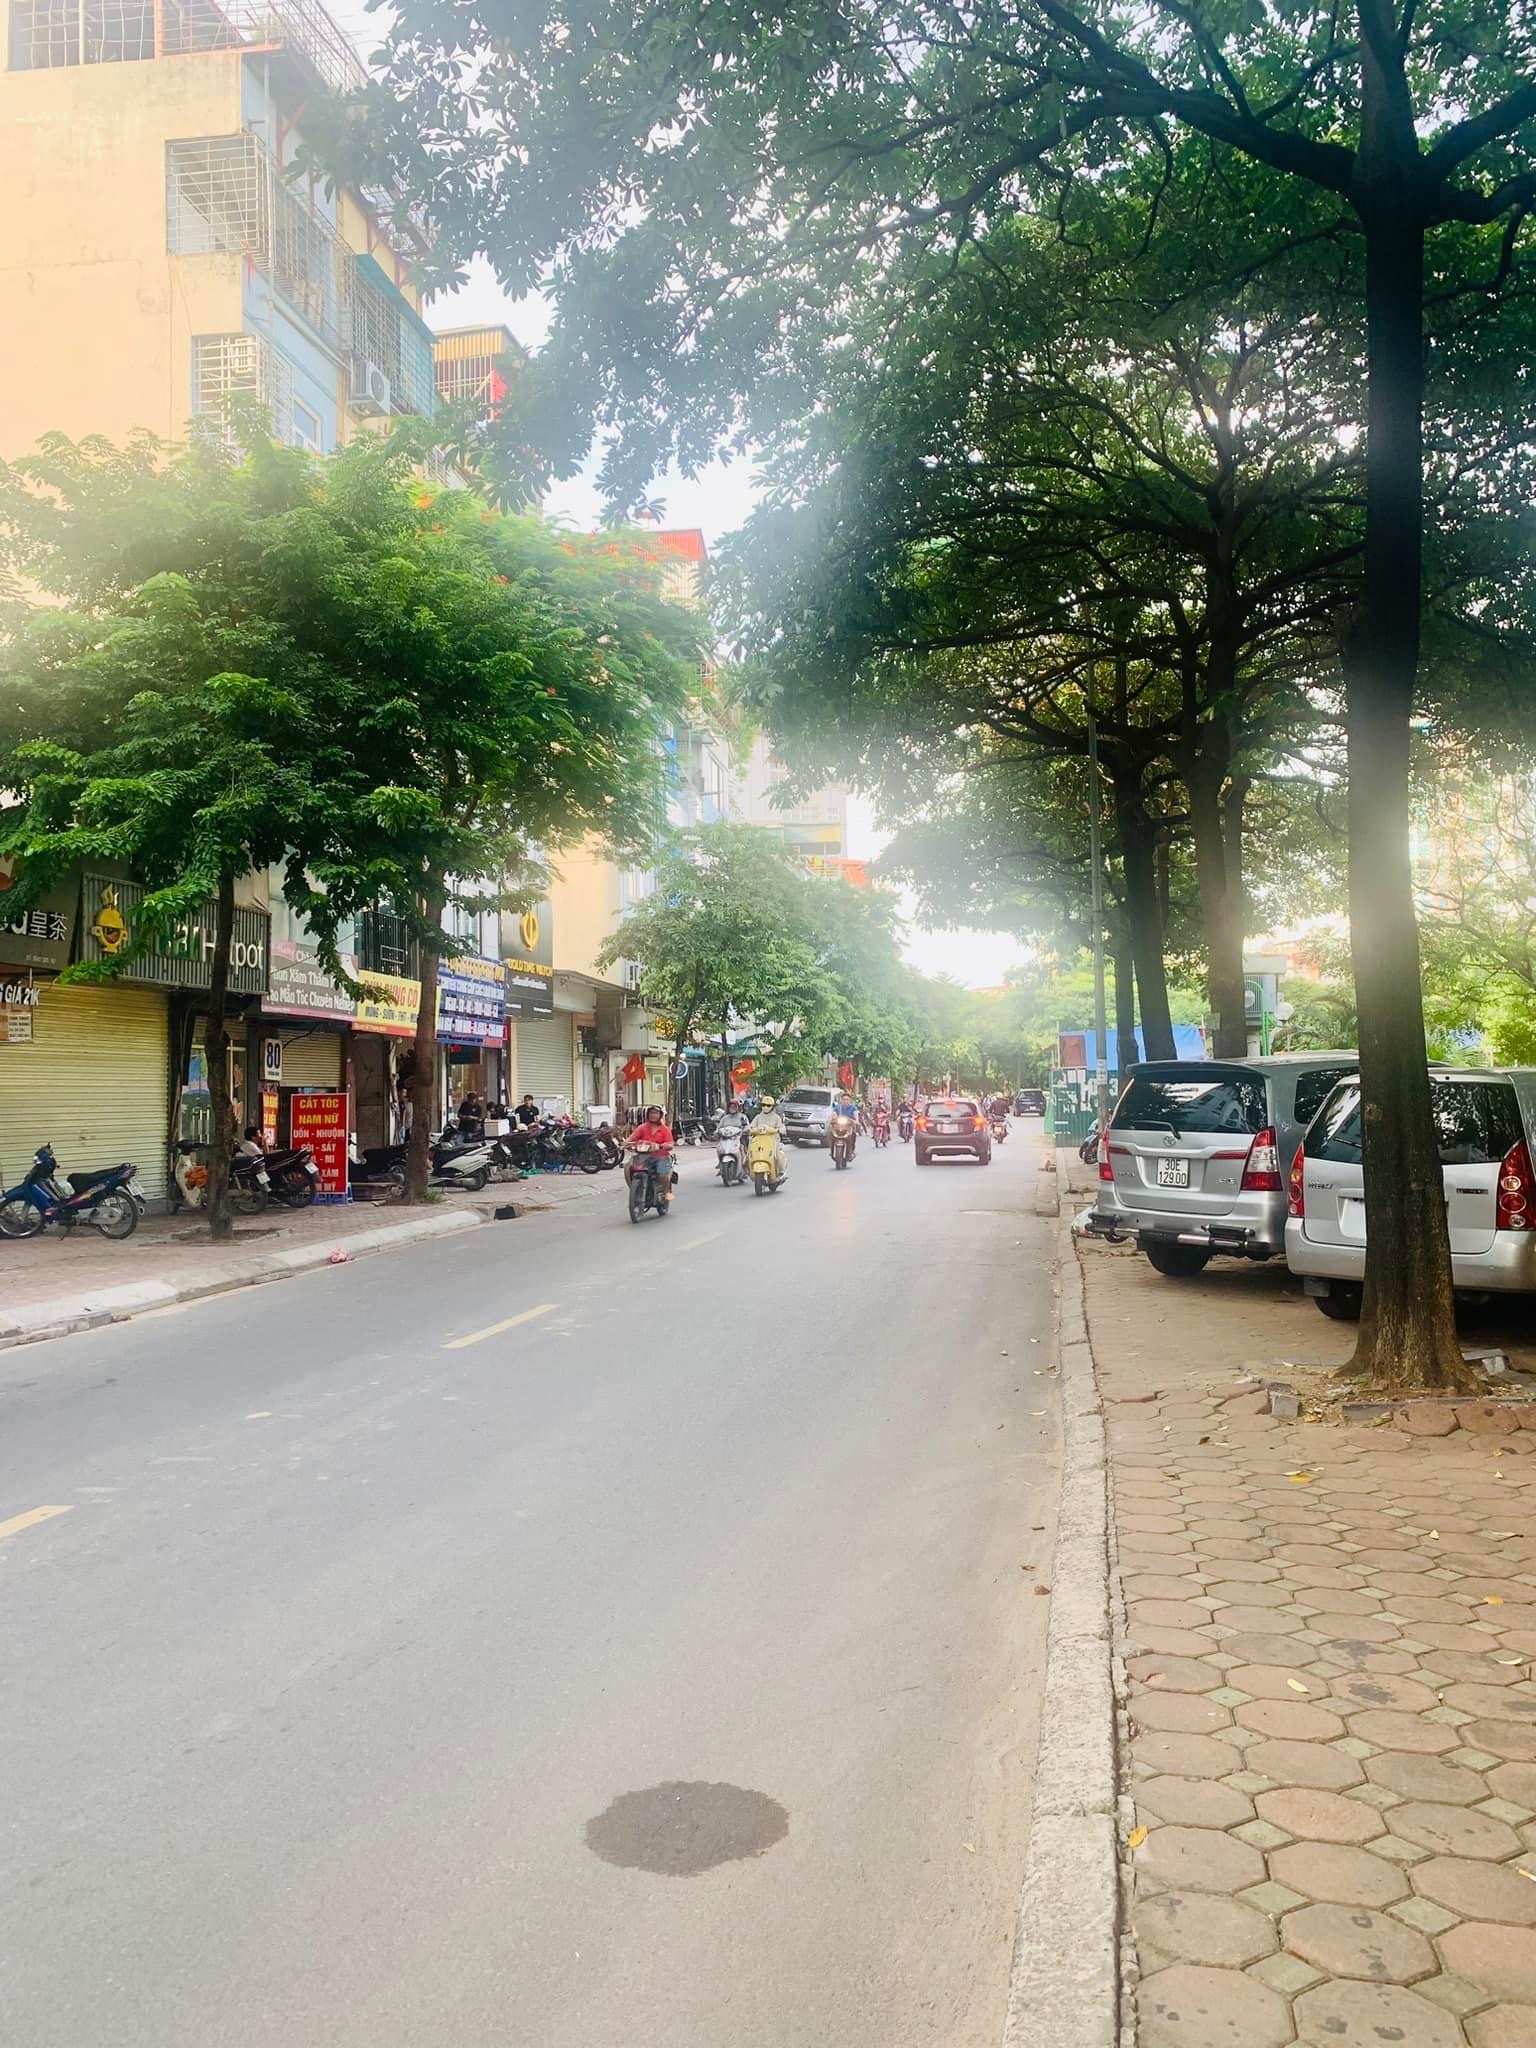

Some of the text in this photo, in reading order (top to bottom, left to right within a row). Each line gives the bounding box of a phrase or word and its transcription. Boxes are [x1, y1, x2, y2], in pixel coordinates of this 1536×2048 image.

[28, 910, 68, 940] 皇茶
[202, 927, 264, 975] Htpot
[4, 980, 22, 1005] GIÁ
[266, 1042, 280, 1069] 80
[321, 1095, 339, 1109] TÓC
[299, 1115, 321, 1125] NAM
[1164, 1158, 1181, 1172] 30E
